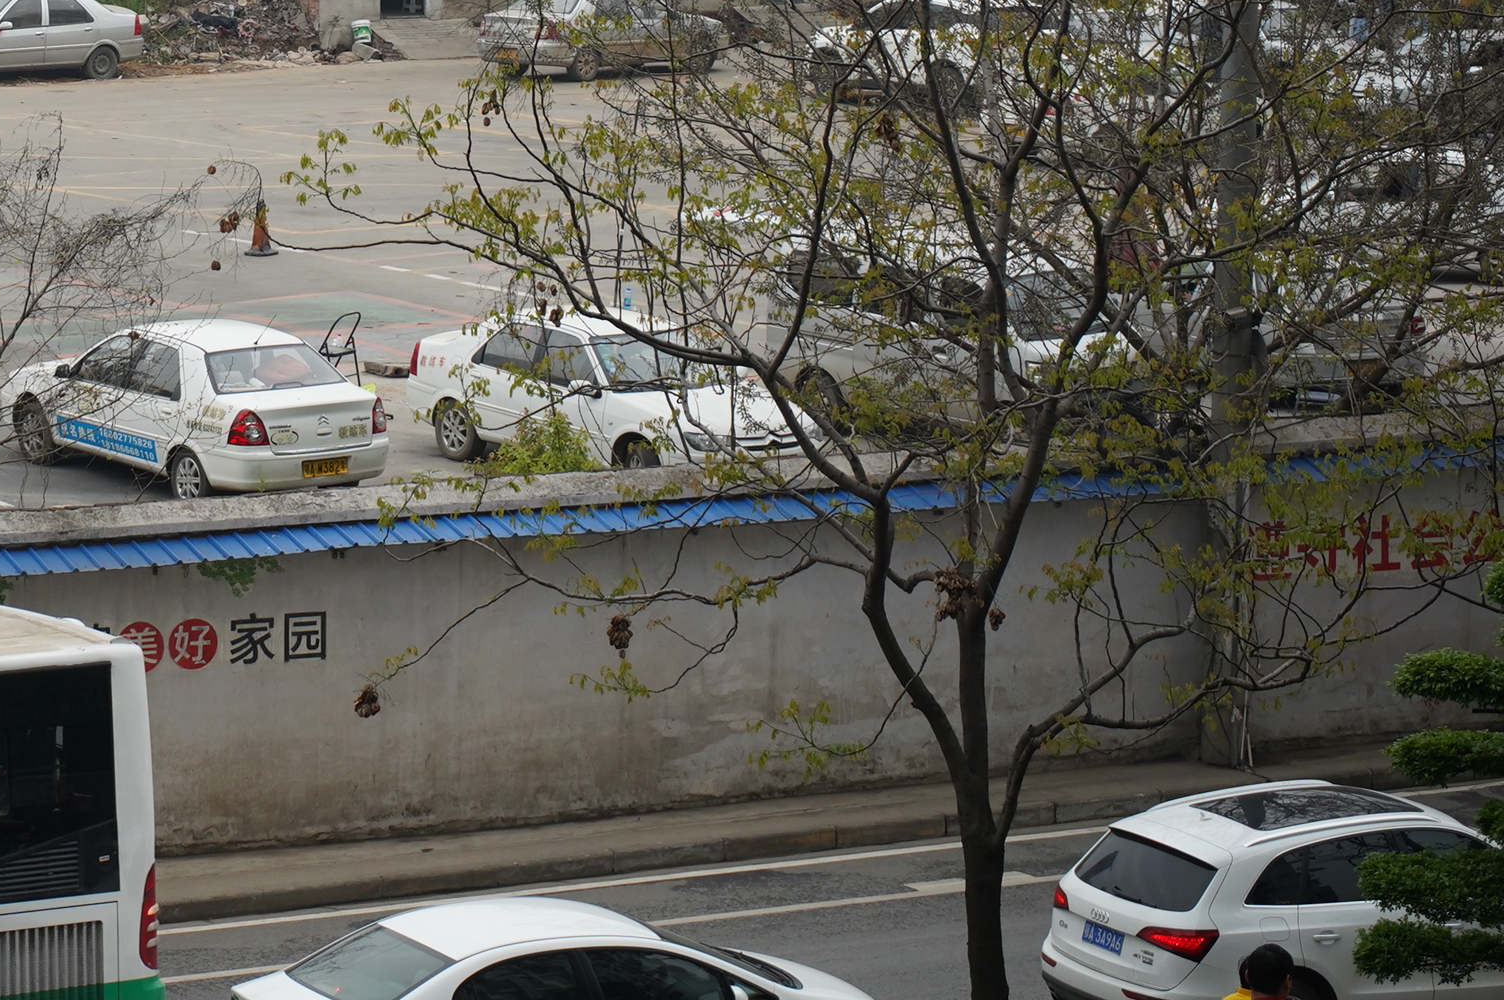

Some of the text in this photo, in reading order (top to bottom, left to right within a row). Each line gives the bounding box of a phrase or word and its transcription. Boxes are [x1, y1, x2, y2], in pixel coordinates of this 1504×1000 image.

[420, 355, 446, 368] 教练车
[94, 611, 327, 665] 美好家园
